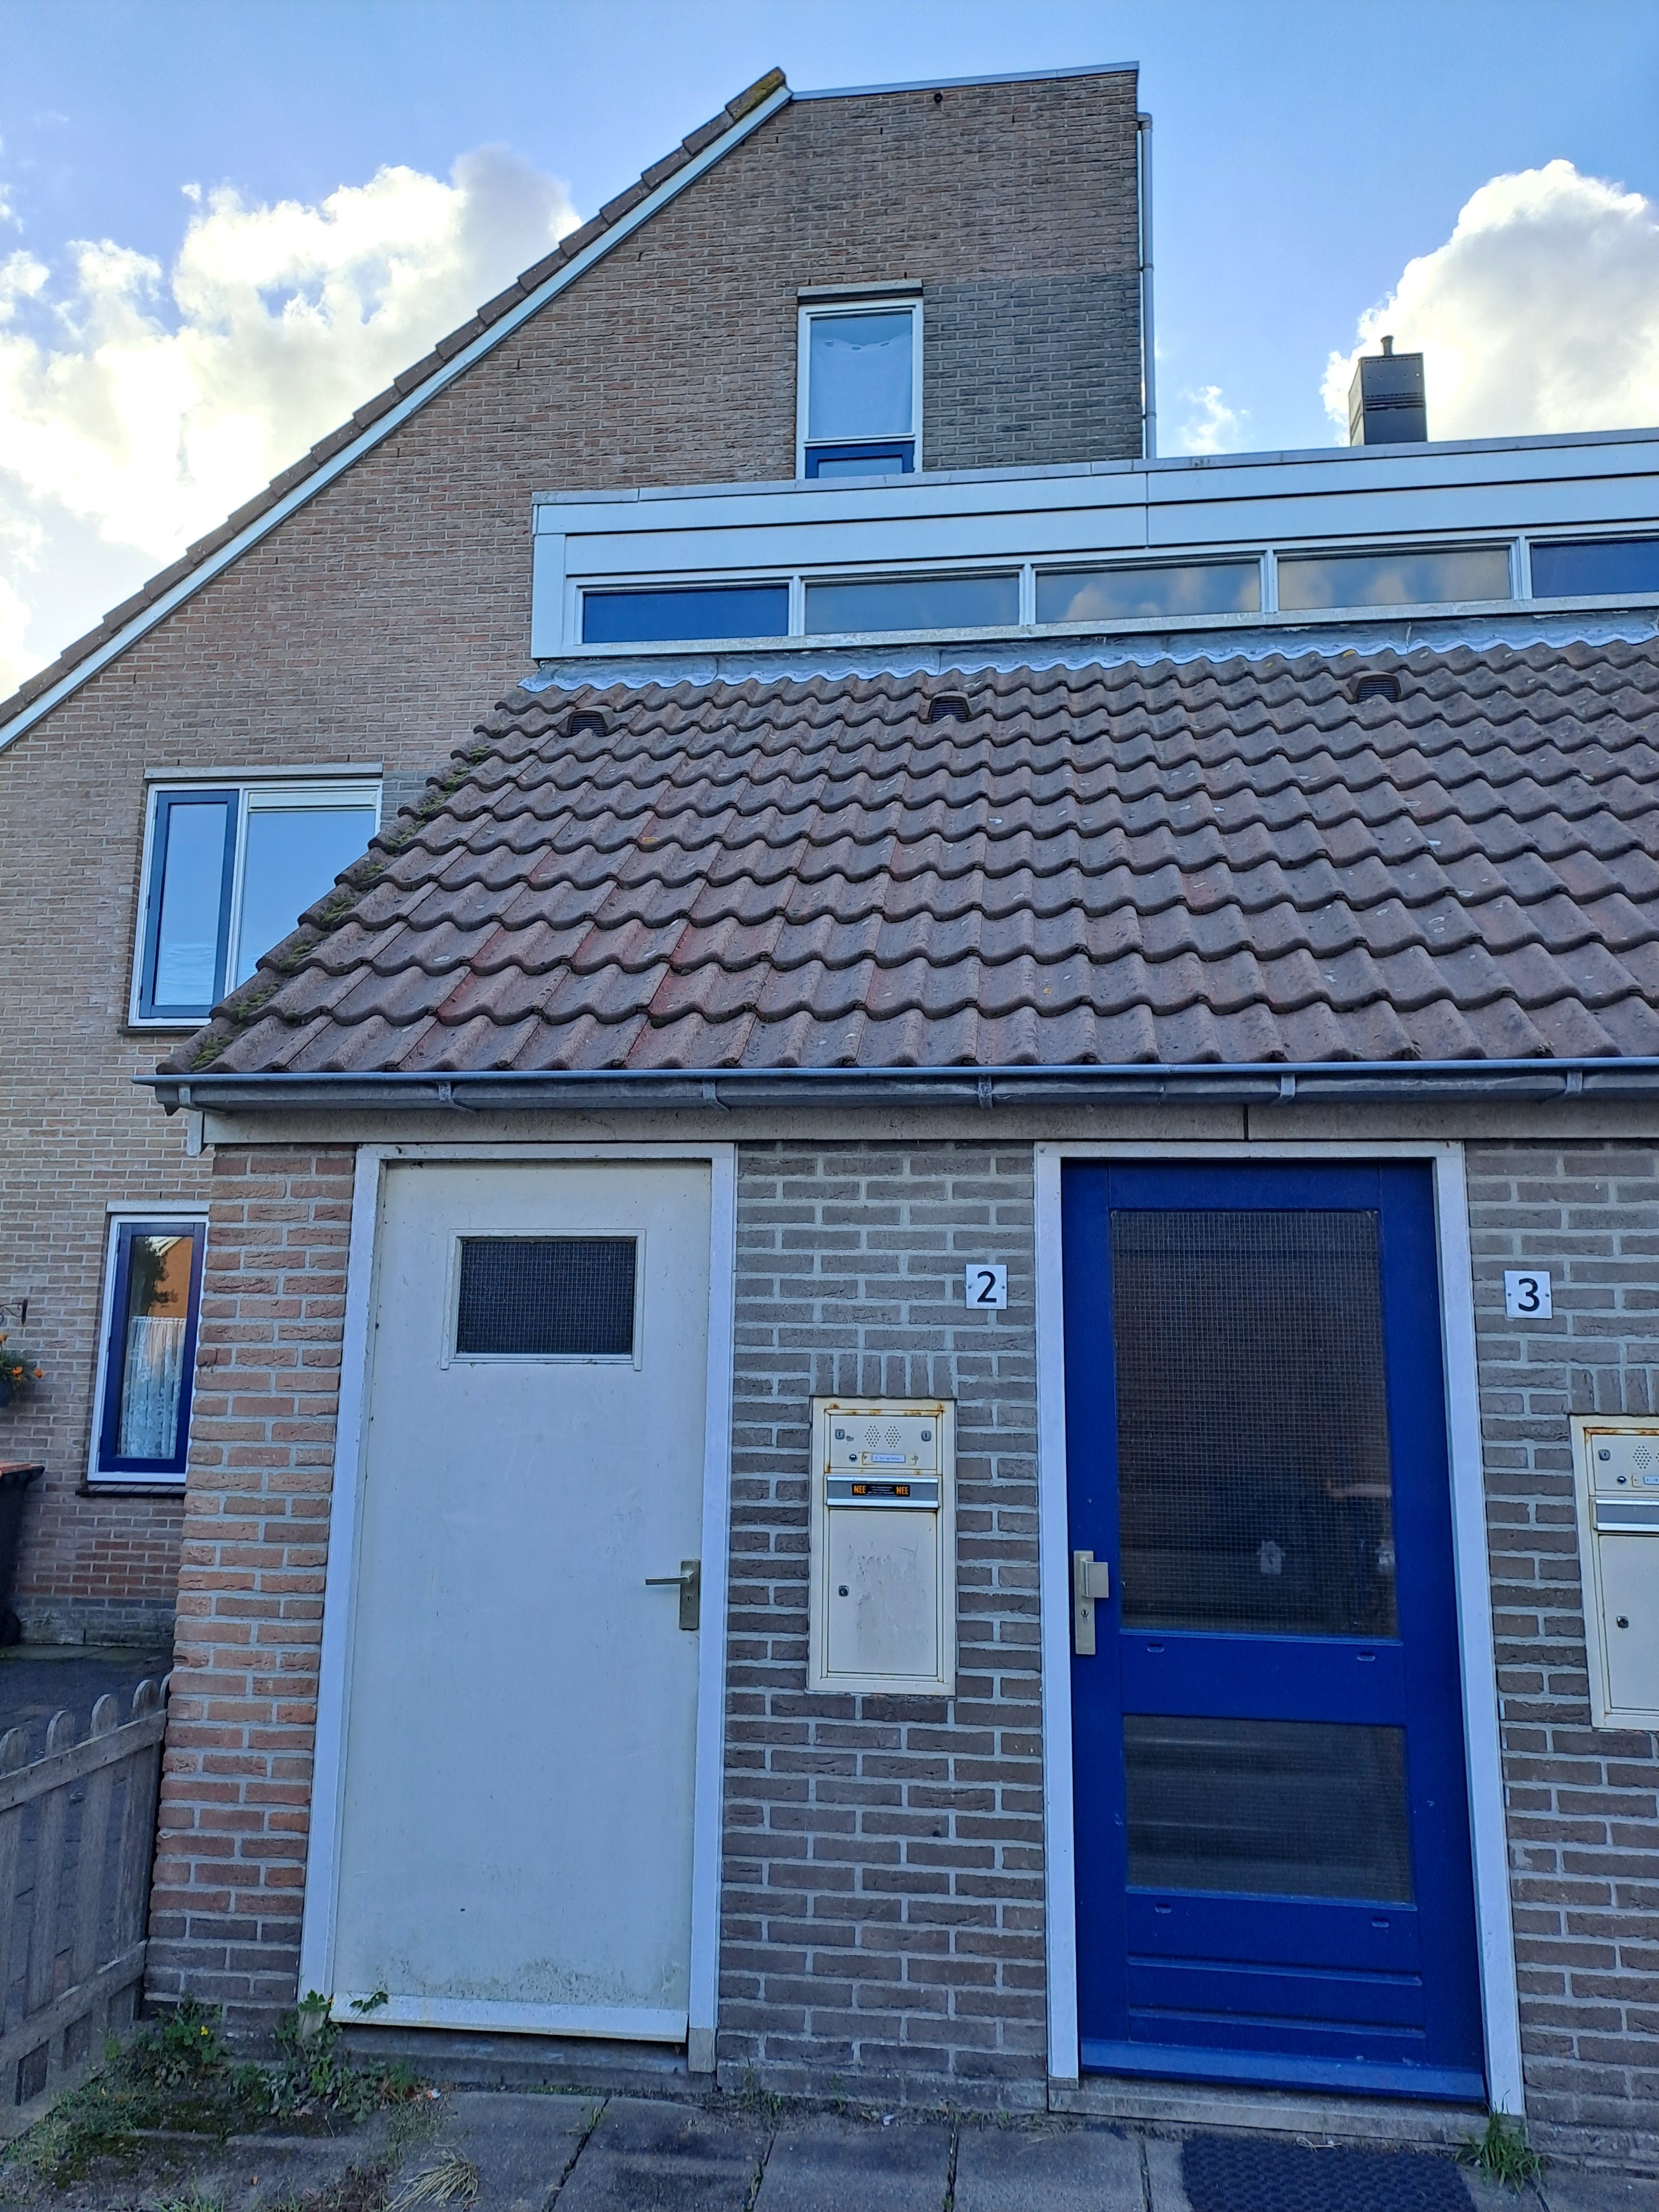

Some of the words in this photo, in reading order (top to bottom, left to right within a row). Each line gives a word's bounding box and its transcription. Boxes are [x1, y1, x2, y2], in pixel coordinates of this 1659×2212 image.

[977, 1271, 997, 1303] 2
[1518, 1278, 1540, 1312] 3
[854, 1485, 866, 1494] NEE
[896, 1486, 909, 1495] NEE
